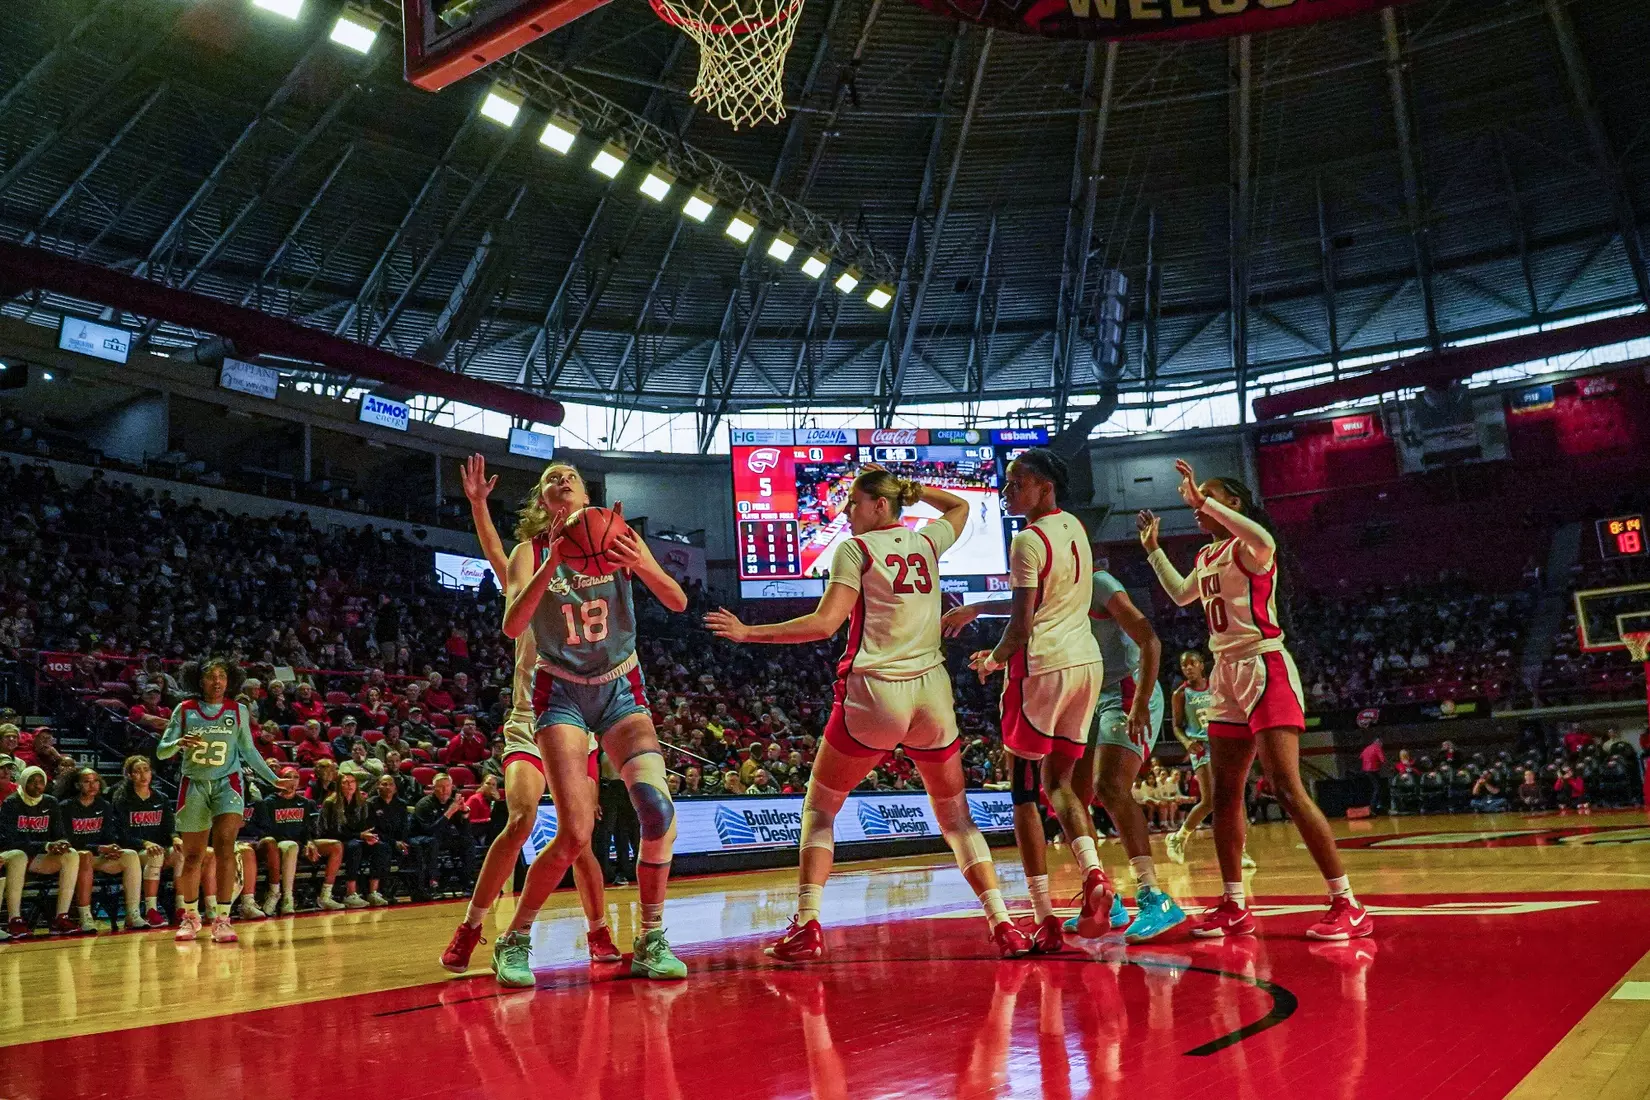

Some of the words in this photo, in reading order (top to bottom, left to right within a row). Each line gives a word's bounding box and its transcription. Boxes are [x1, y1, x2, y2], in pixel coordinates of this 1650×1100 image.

[364, 397, 408, 420] ATMOS
[807, 430, 836, 440] LOGAN
[759, 477, 772, 497] 5
[1610, 518, 1641, 535] 8:14
[1617, 531, 1641, 553] 18
[1070, 540, 1080, 584] 1
[885, 553, 932, 594] 23
[561, 599, 608, 645] 18
[49, 663, 72, 672] 105
[191, 741, 228, 767] 23
[129, 809, 163, 824] WKU
[275, 807, 305, 821] WKU
[743, 808, 801, 826] Builders
[878, 804, 924, 819] Builders
[17, 814, 49, 829] WKU
[72, 817, 104, 831] WKU
[892, 818, 930, 835] Design
[760, 825, 802, 845] Desig
